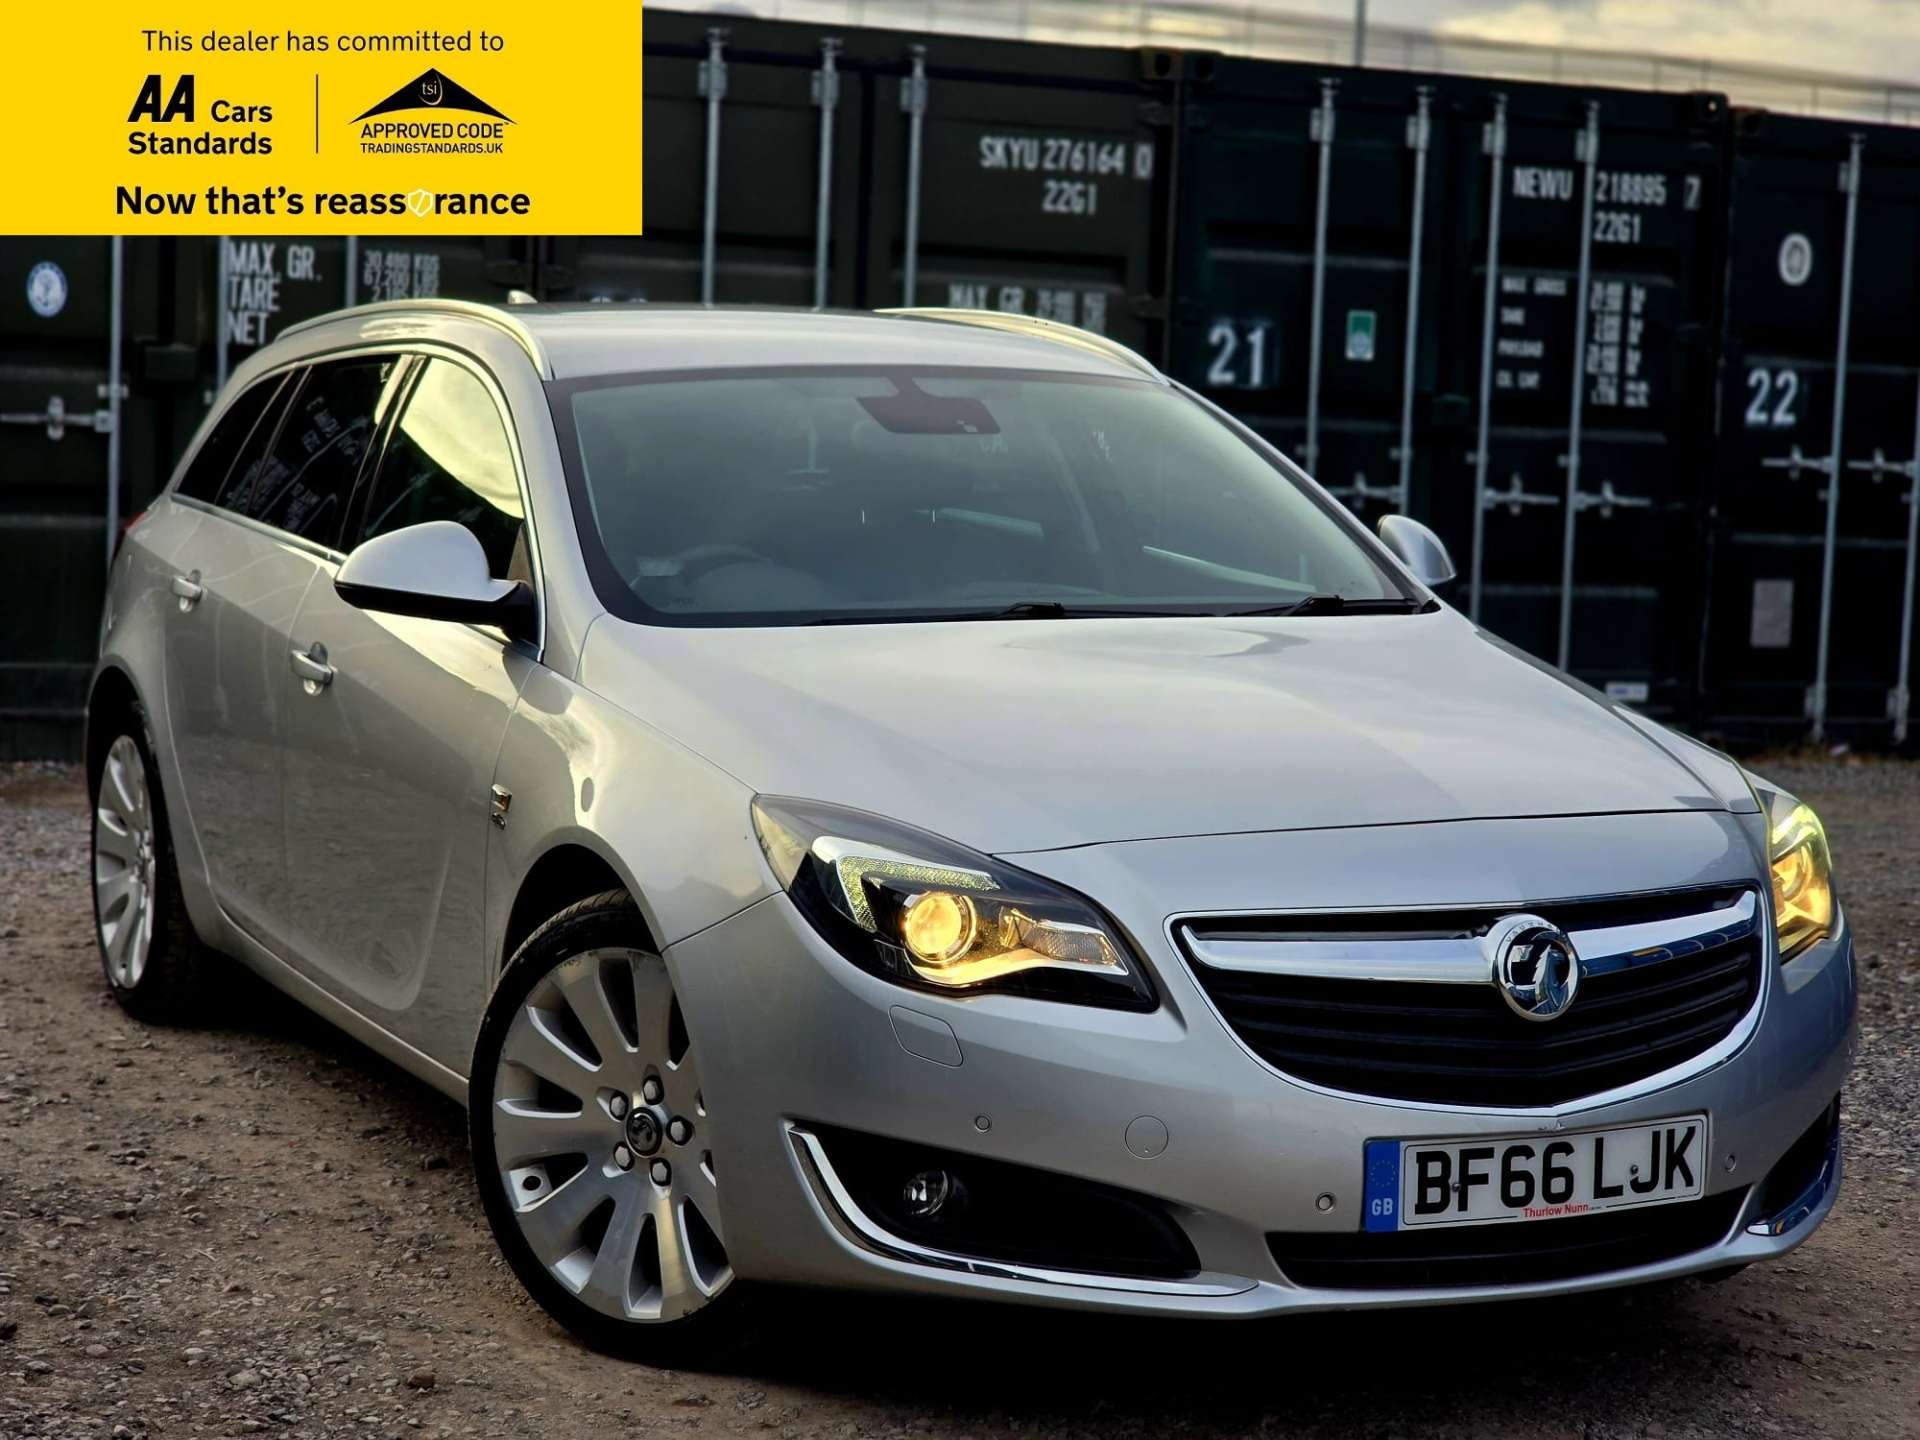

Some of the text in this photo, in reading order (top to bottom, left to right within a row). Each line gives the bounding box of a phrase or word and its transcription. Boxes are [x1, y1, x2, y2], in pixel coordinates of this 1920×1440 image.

[979, 136, 1040, 171] SKYU
[1041, 139, 1126, 175] 276164
[1041, 179, 1098, 216] 22G1
[1512, 166, 1574, 200] NEWU
[1593, 209, 1641, 244] 22G1
[228, 274, 281, 312] TARE
[225, 309, 271, 345] NET
[1208, 325, 1265, 387] 21
[1745, 367, 1799, 426] 22
[1506, 921, 1566, 944] VAUXH
[1415, 1126, 1698, 1216] BF66 LJK
[1371, 1197, 1393, 1217] GB
[1523, 1205, 1561, 1218] Thurlow
[1564, 1203, 1589, 1214] Nunn
